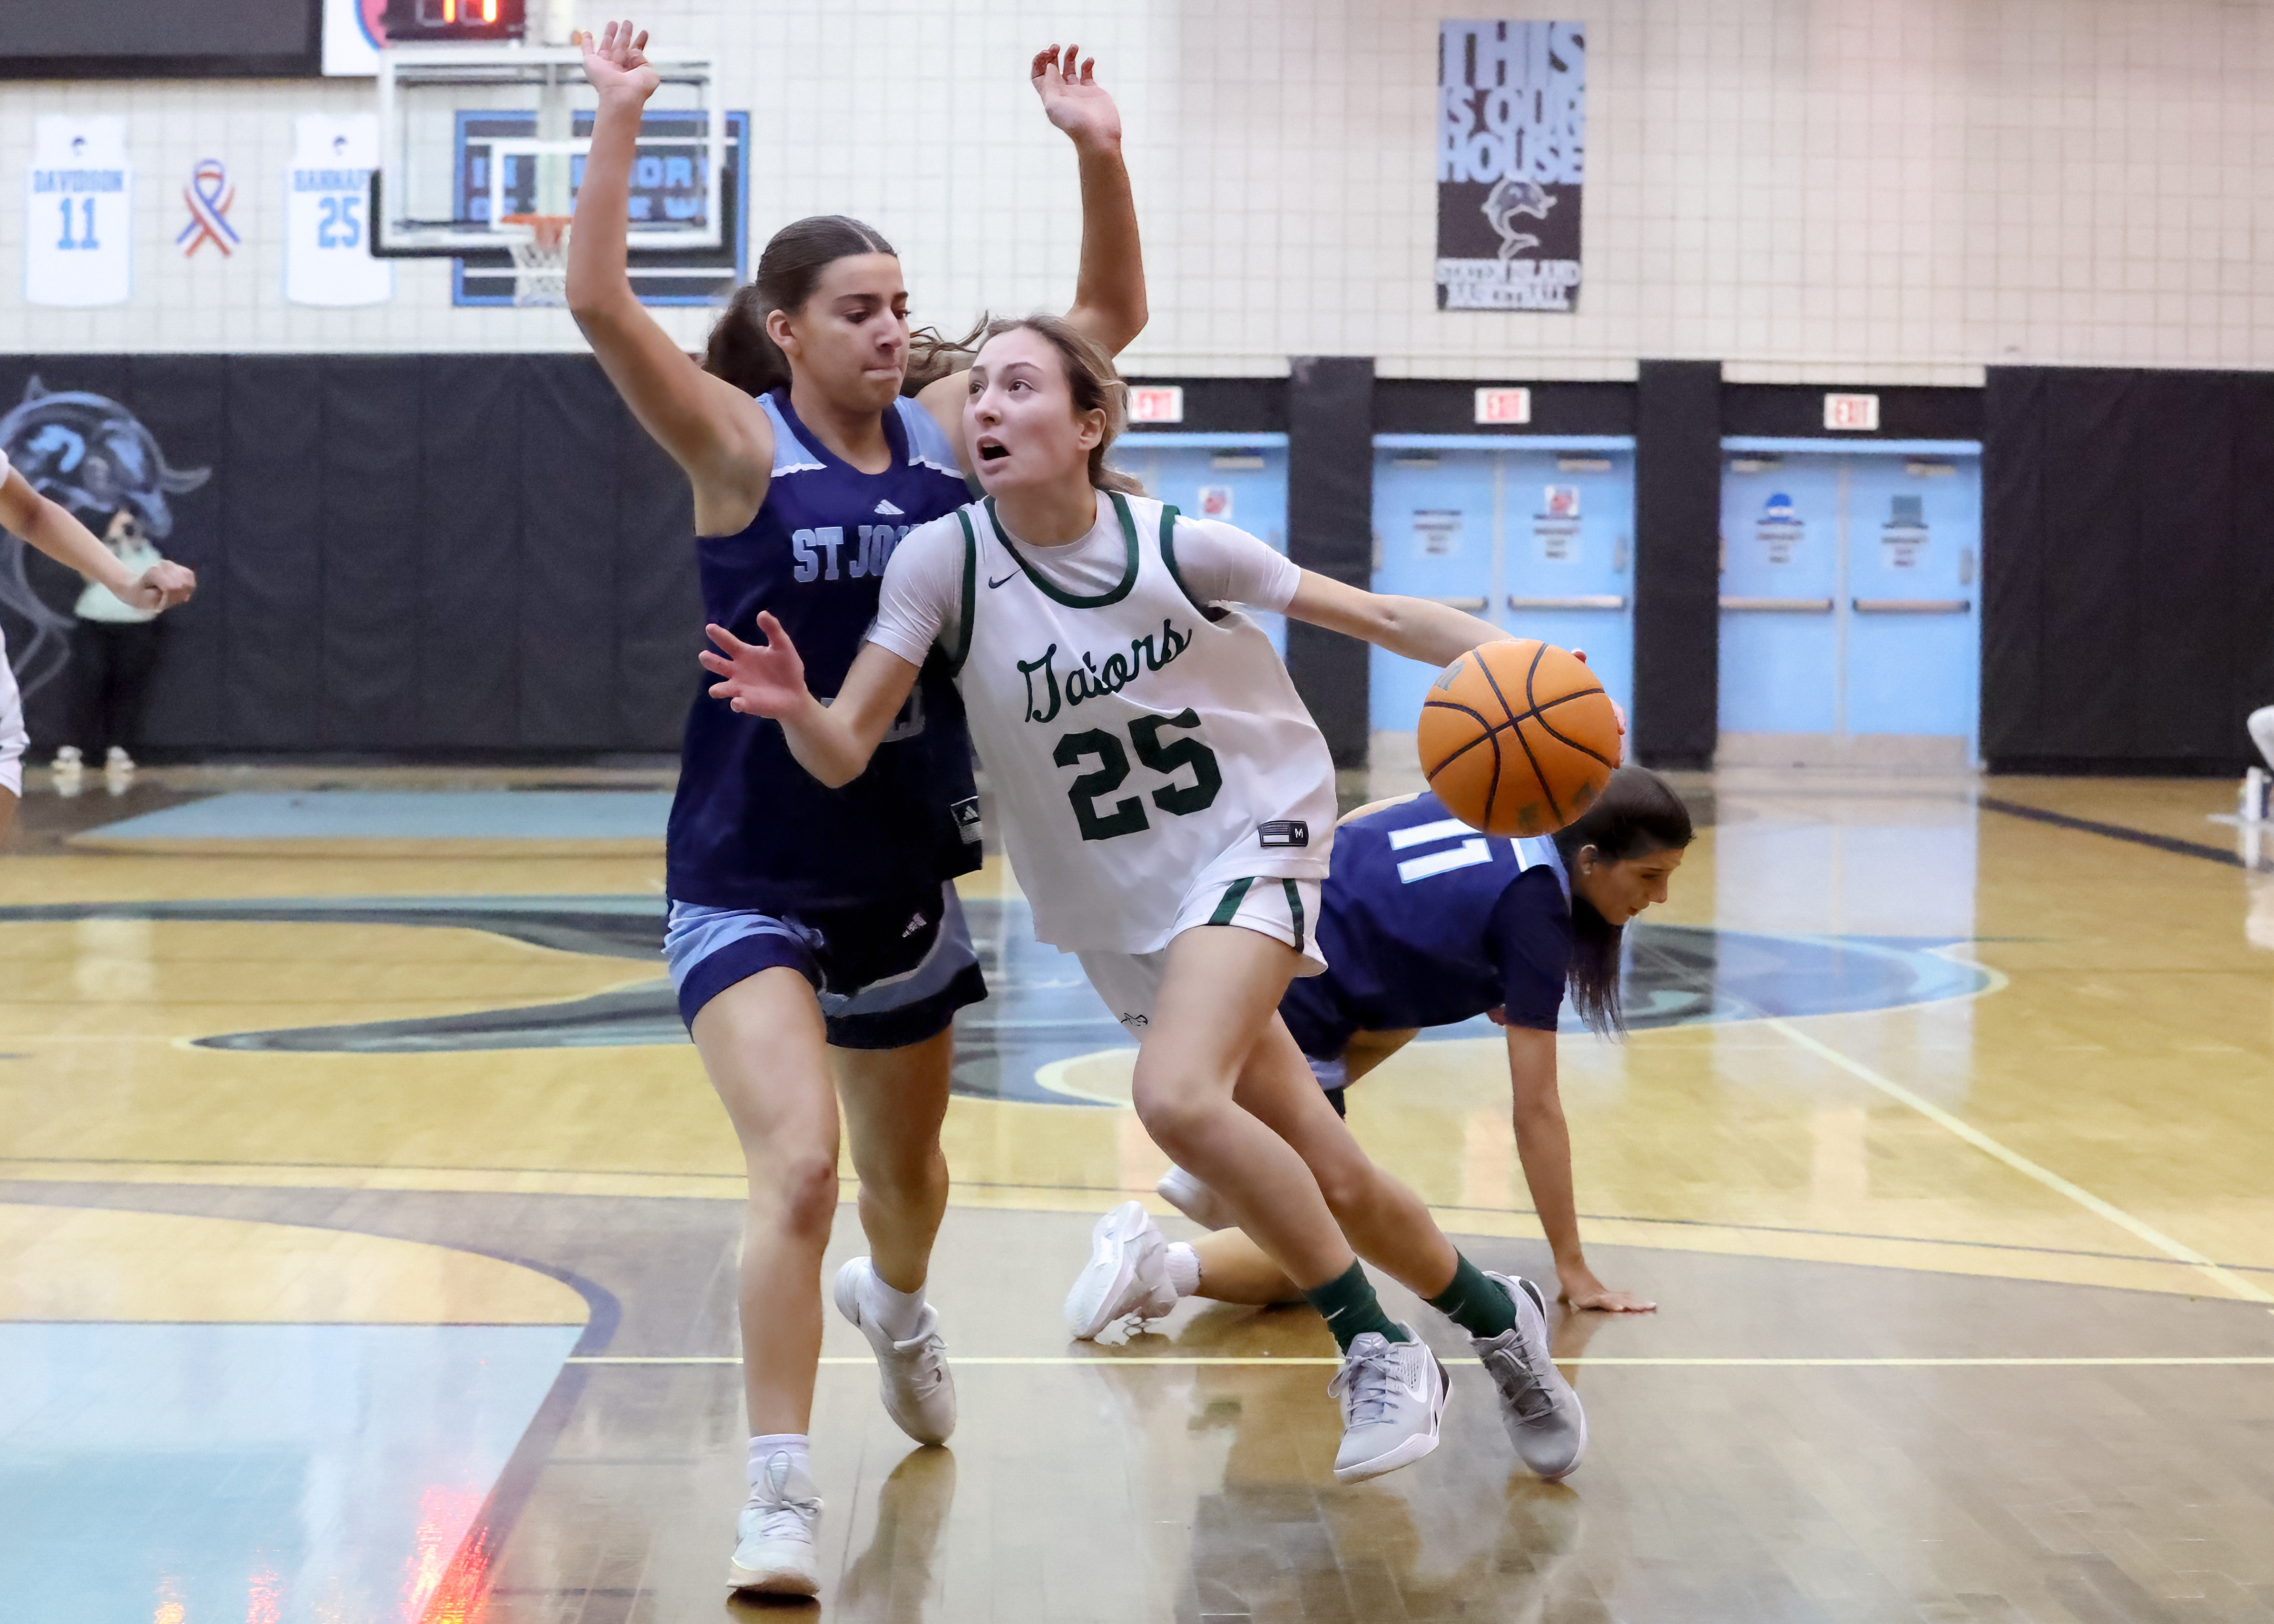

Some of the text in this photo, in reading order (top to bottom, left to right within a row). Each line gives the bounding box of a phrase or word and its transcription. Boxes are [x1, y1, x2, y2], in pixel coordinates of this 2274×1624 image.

[1439, 20, 1585, 88] THIS
[1439, 87, 1586, 137] IS OUR
[1437, 131, 1585, 184] HOUSE
[57, 196, 100, 250] 11
[318, 196, 361, 248] 25
[792, 527, 844, 583] ST
[1052, 707, 1223, 841] 25
[1388, 817, 1493, 884] 11
